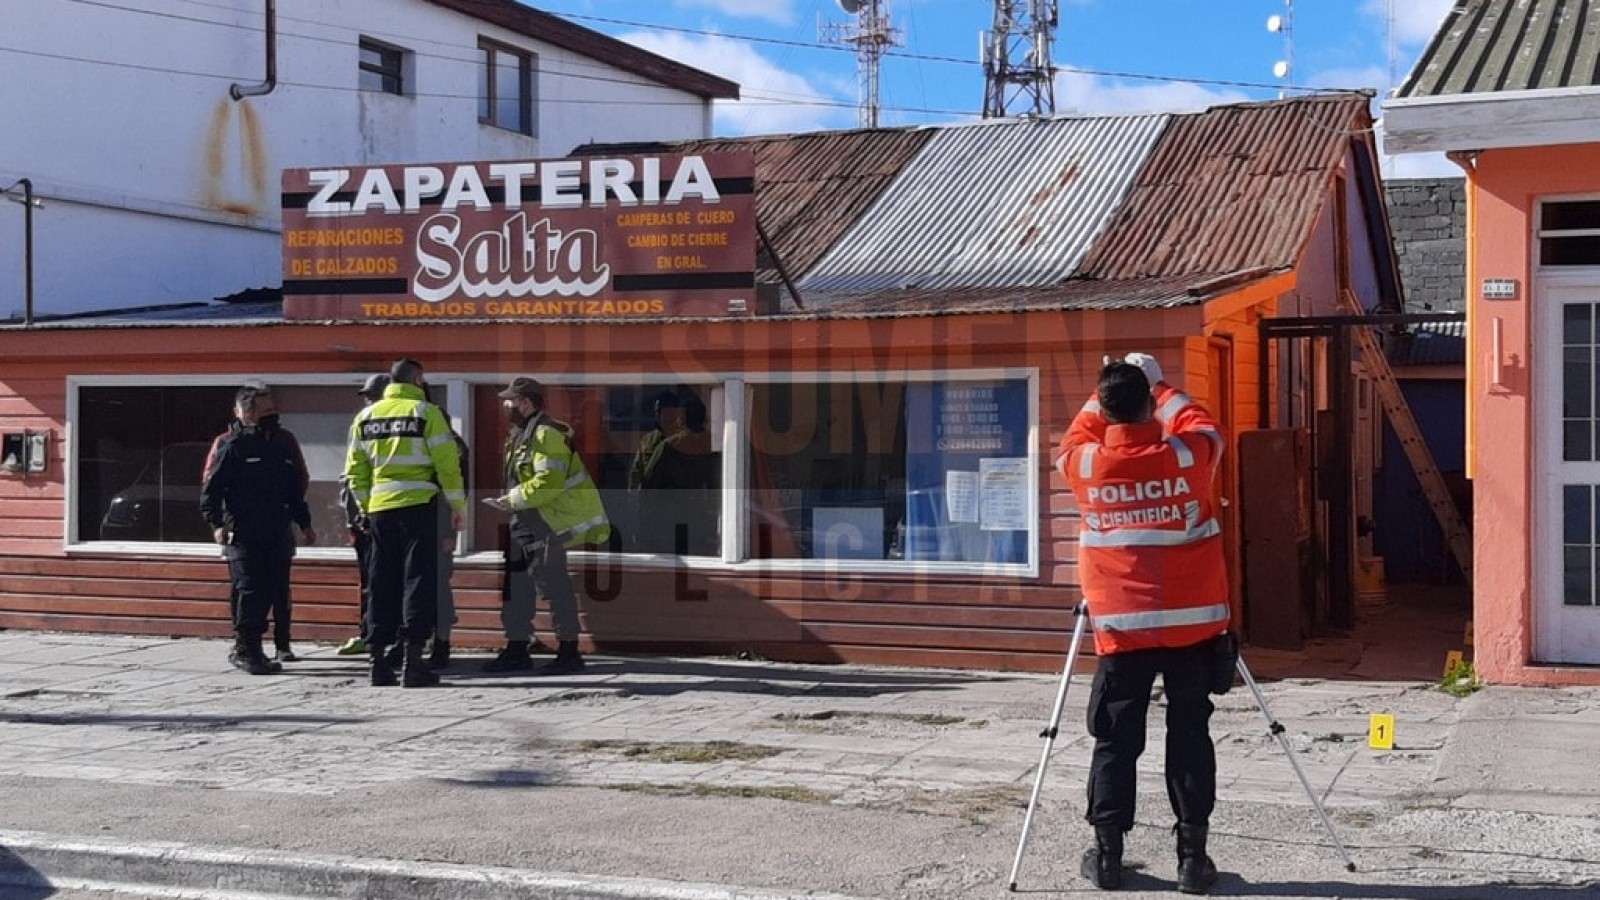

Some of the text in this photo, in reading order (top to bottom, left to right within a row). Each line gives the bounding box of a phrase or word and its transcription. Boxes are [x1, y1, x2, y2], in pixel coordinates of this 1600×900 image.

[306, 156, 721, 217] ZAPATERIA
[616, 210, 735, 227] CAMPERAS DE CUERO
[287, 227, 404, 247] REPARACIONES
[627, 232, 728, 248] CAMBIO DE CIERRE
[413, 210, 610, 301] Salta
[657, 256, 672, 270] EN
[291, 257, 398, 276] DE CALZADOS
[362, 299, 665, 317] TRABAJOS GARANTIZADOS
[363, 421, 418, 435] POLICIA
[1087, 477, 1191, 504] POLICIA
[1100, 504, 1182, 528] CIENTIFICA
[1376, 725, 1385, 739] 1
